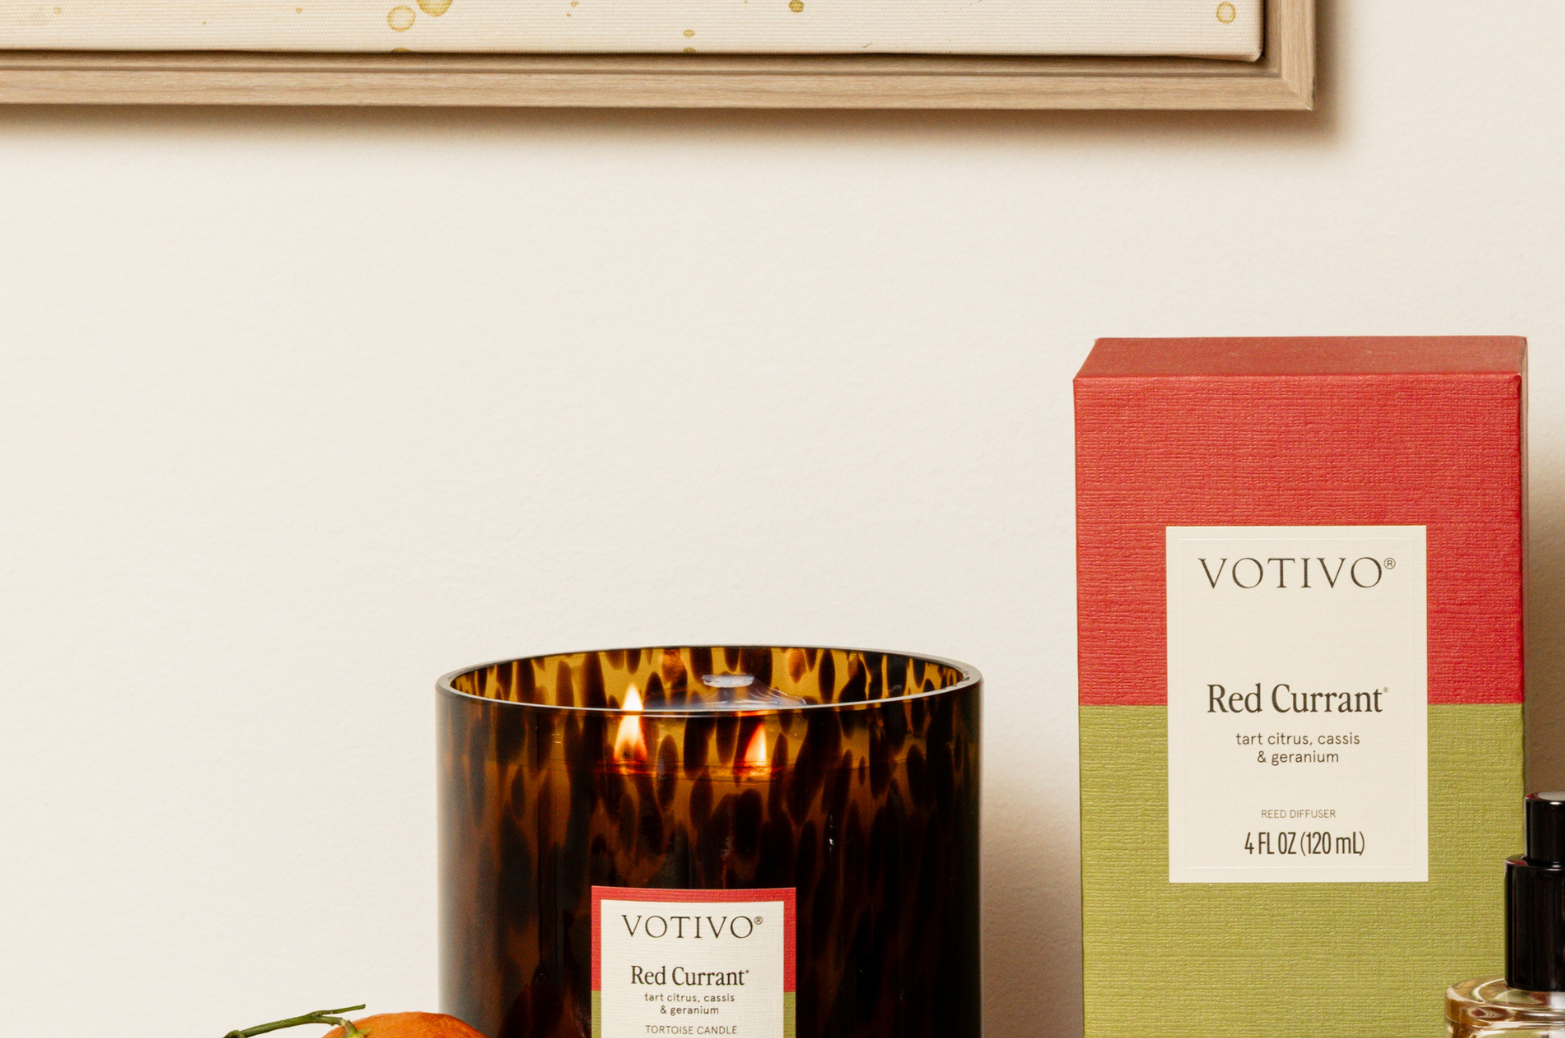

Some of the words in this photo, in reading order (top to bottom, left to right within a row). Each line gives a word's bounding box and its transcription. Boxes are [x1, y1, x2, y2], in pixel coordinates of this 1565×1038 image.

[1206, 682, 1264, 714] Red
[1235, 732, 1263, 746] tart
[1267, 731, 1313, 748] citrus,
[1317, 731, 1361, 745] cassis
[1256, 750, 1267, 764] &
[1271, 750, 1339, 767] geranium
[1261, 808, 1287, 819] REED
[1289, 808, 1336, 819] DIFFUSER
[1243, 831, 1255, 855] 4
[1258, 831, 1275, 855] FL
[1277, 831, 1297, 855] OZ
[1299, 831, 1332, 857] (120
[1335, 830, 1366, 857] mL)
[630, 965, 667, 986] Red
[644, 992, 664, 1003] tart
[666, 992, 701, 1005] citrus,
[703, 992, 735, 1003] cassis
[659, 1004, 667, 1015] &
[670, 1004, 719, 1017] geranium
[645, 1024, 694, 1035] TORTOISE
[696, 1024, 738, 1035] CANDLE
